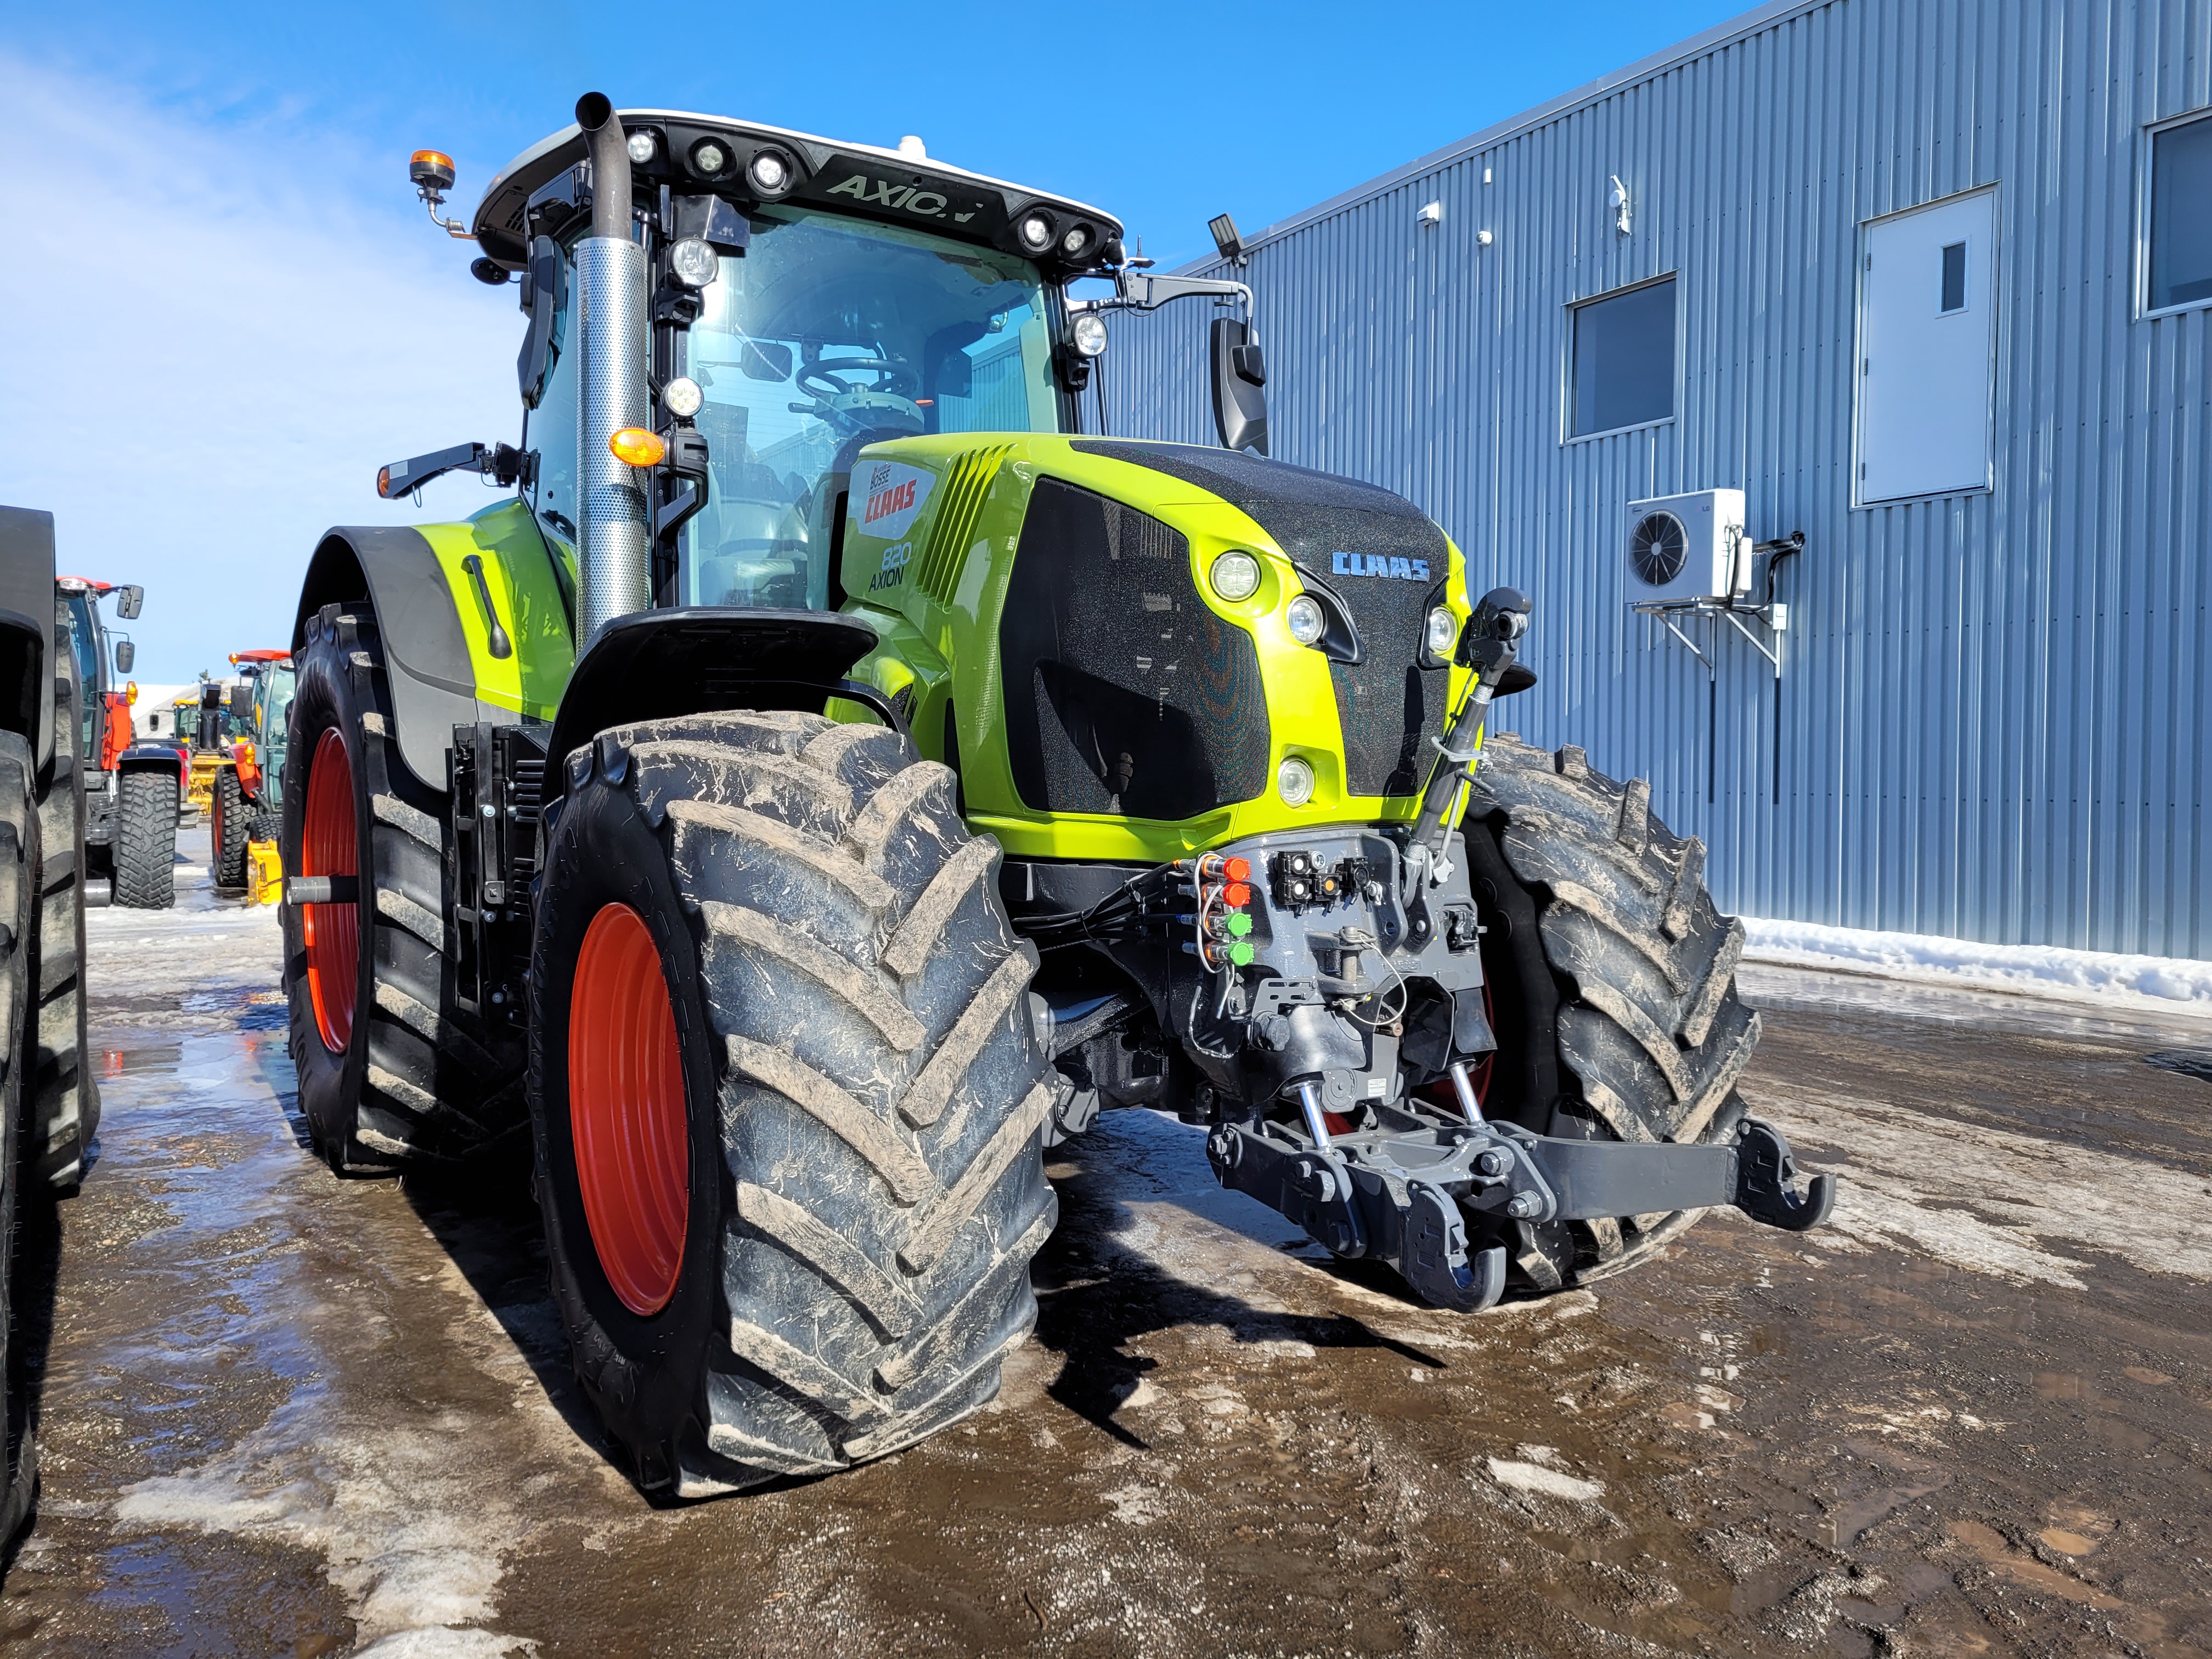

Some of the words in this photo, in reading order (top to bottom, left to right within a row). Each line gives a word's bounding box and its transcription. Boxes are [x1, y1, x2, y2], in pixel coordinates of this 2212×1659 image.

[826, 174, 984, 223] AXIO
[870, 468, 891, 490] BOSSE
[865, 478, 917, 524] CLAAS
[882, 541, 912, 570] 820
[1332, 552, 1430, 583] CLAAS
[868, 566, 905, 592] AXION
[555, 827, 581, 890] 30
